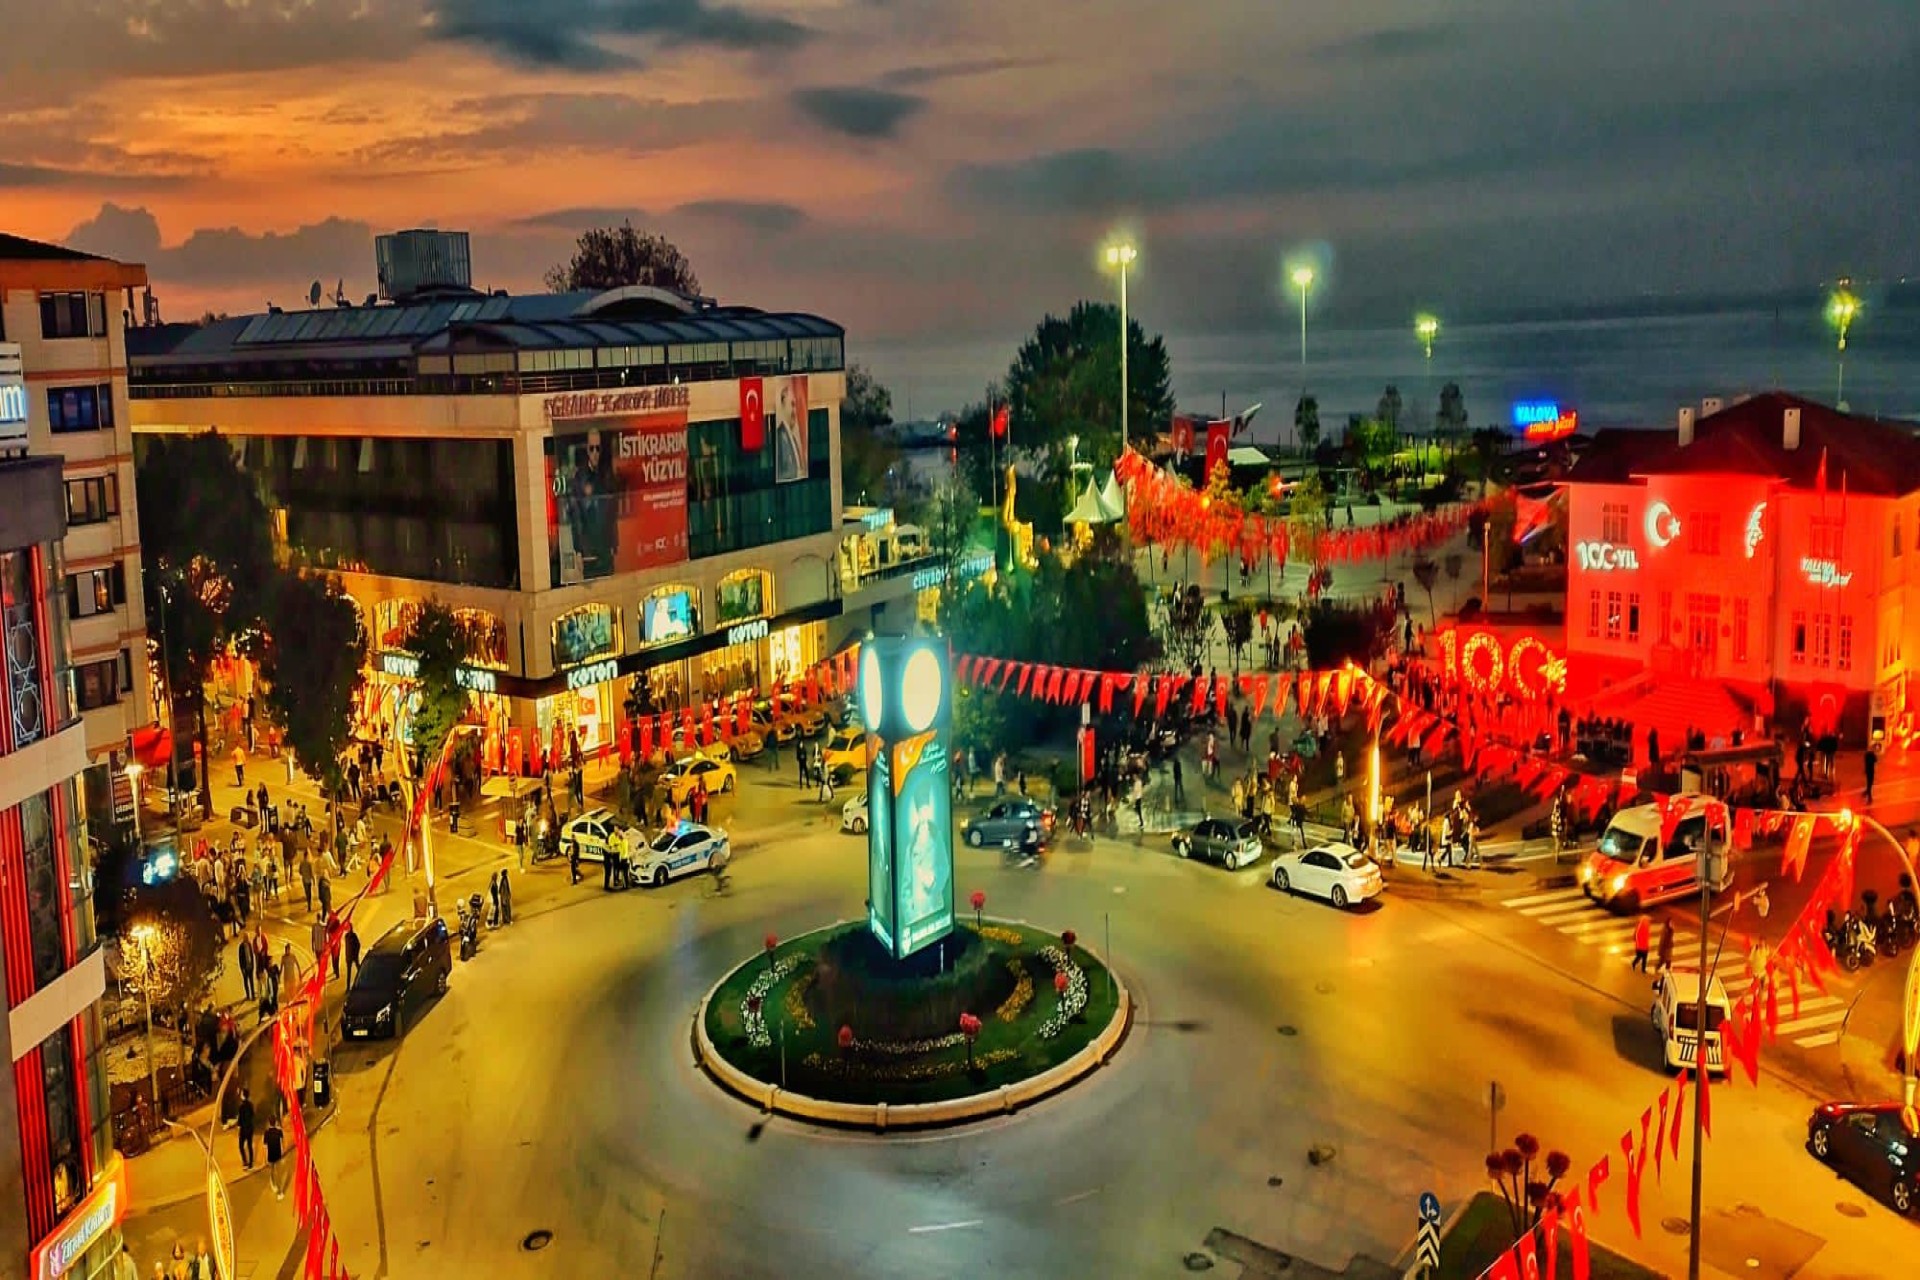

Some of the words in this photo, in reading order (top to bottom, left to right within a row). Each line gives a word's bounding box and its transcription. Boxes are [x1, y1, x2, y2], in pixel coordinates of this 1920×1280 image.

[1516, 405, 1558, 422] YALOVA
[619, 430, 687, 458] İSTİKRARIN
[729, 619, 768, 646] KOTON
[568, 659, 618, 691] KOTON
